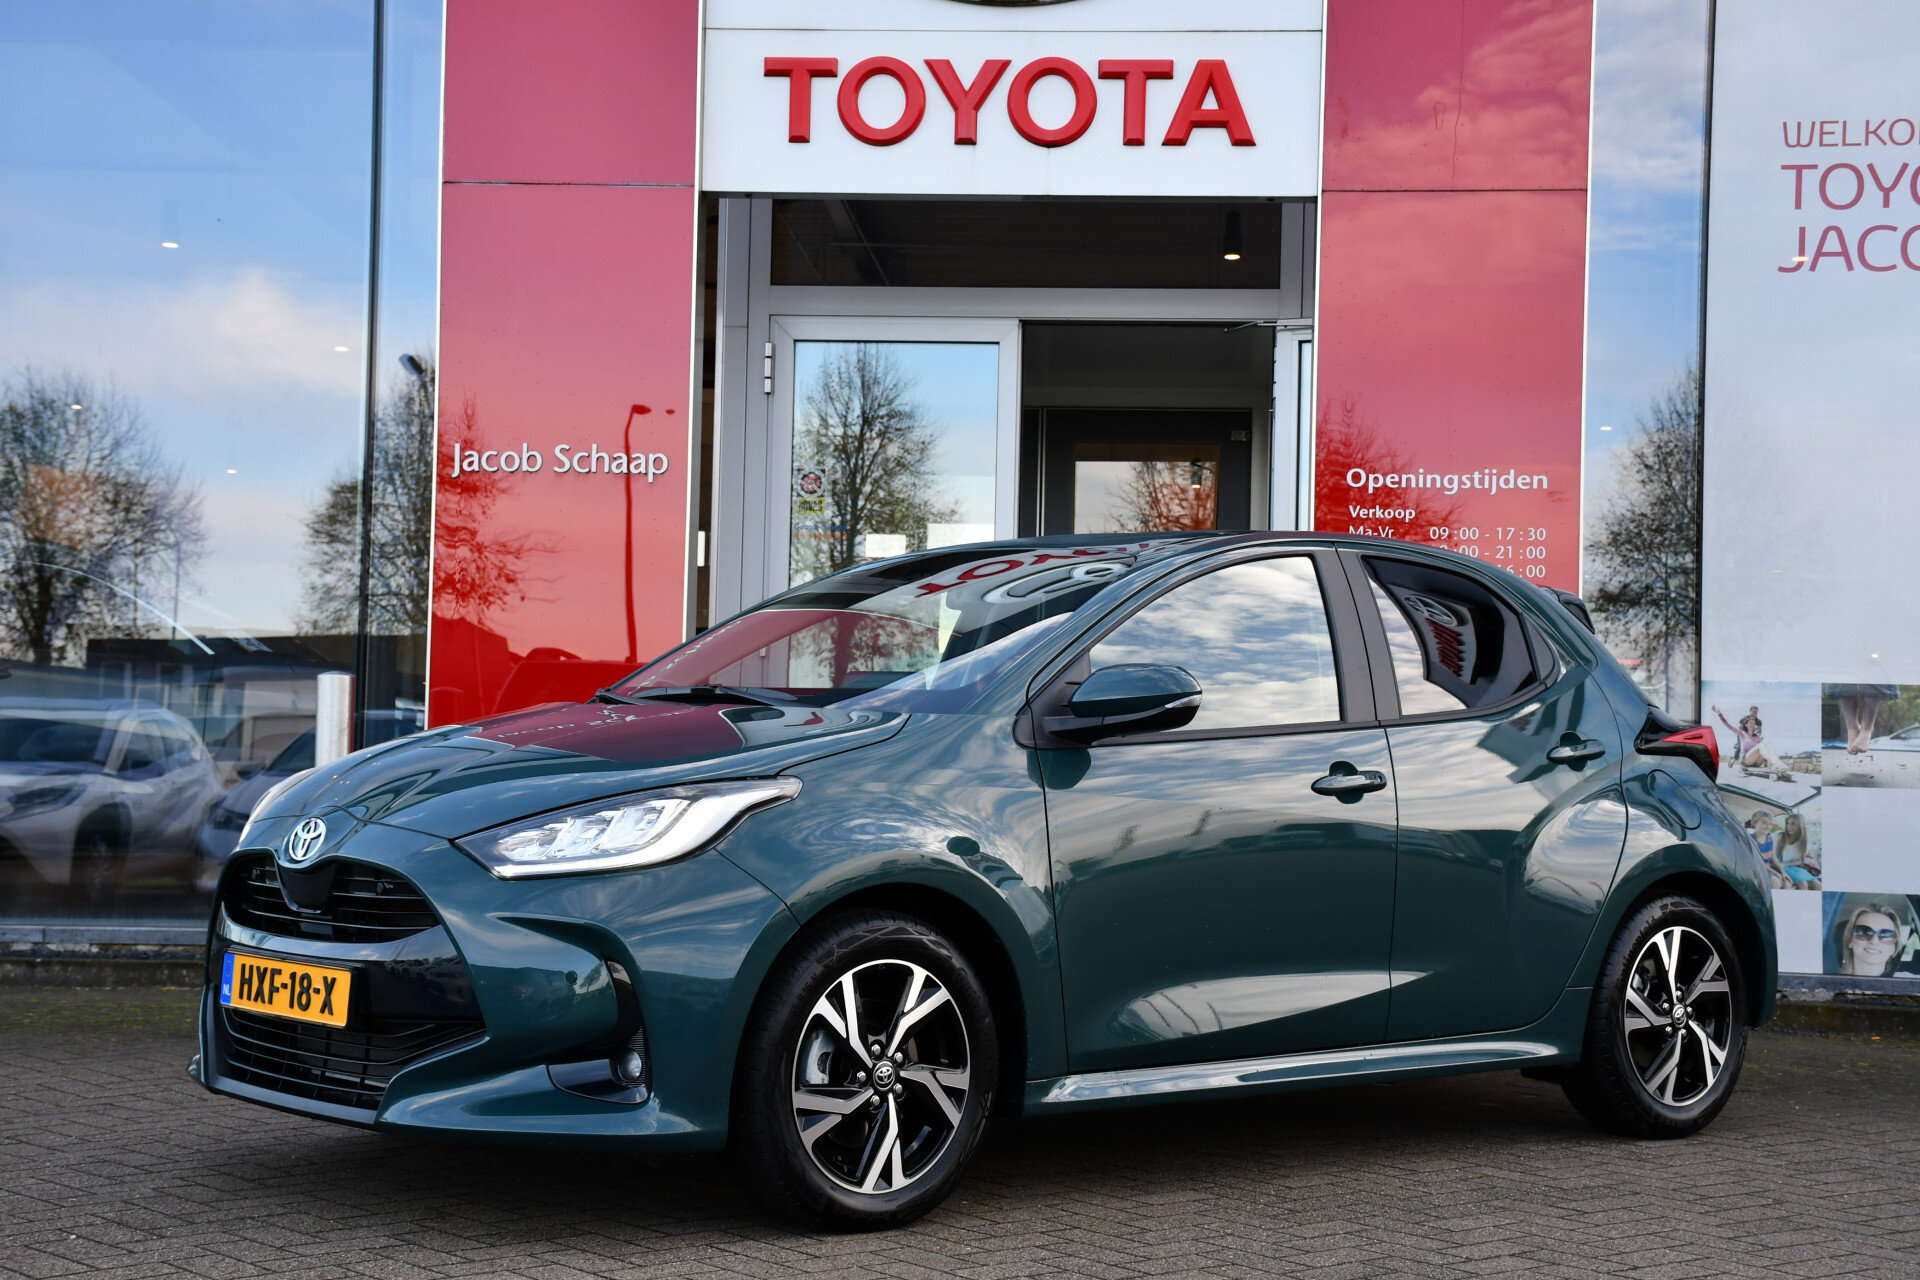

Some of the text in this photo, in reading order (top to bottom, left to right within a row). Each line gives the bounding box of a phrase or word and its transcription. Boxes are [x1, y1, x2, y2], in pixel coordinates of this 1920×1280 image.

[764, 55, 1257, 147] TOYOTA
[1783, 118, 1920, 148] WELKO
[1781, 162, 1920, 210] TOY
[452, 442, 669, 484] Jacob Schaap
[1346, 467, 1549, 496] Openingstijden
[1349, 504, 1416, 523] Verkoop
[1496, 564, 1546, 578] 6:00
[222, 963, 337, 1016] NL HXF-18-X
